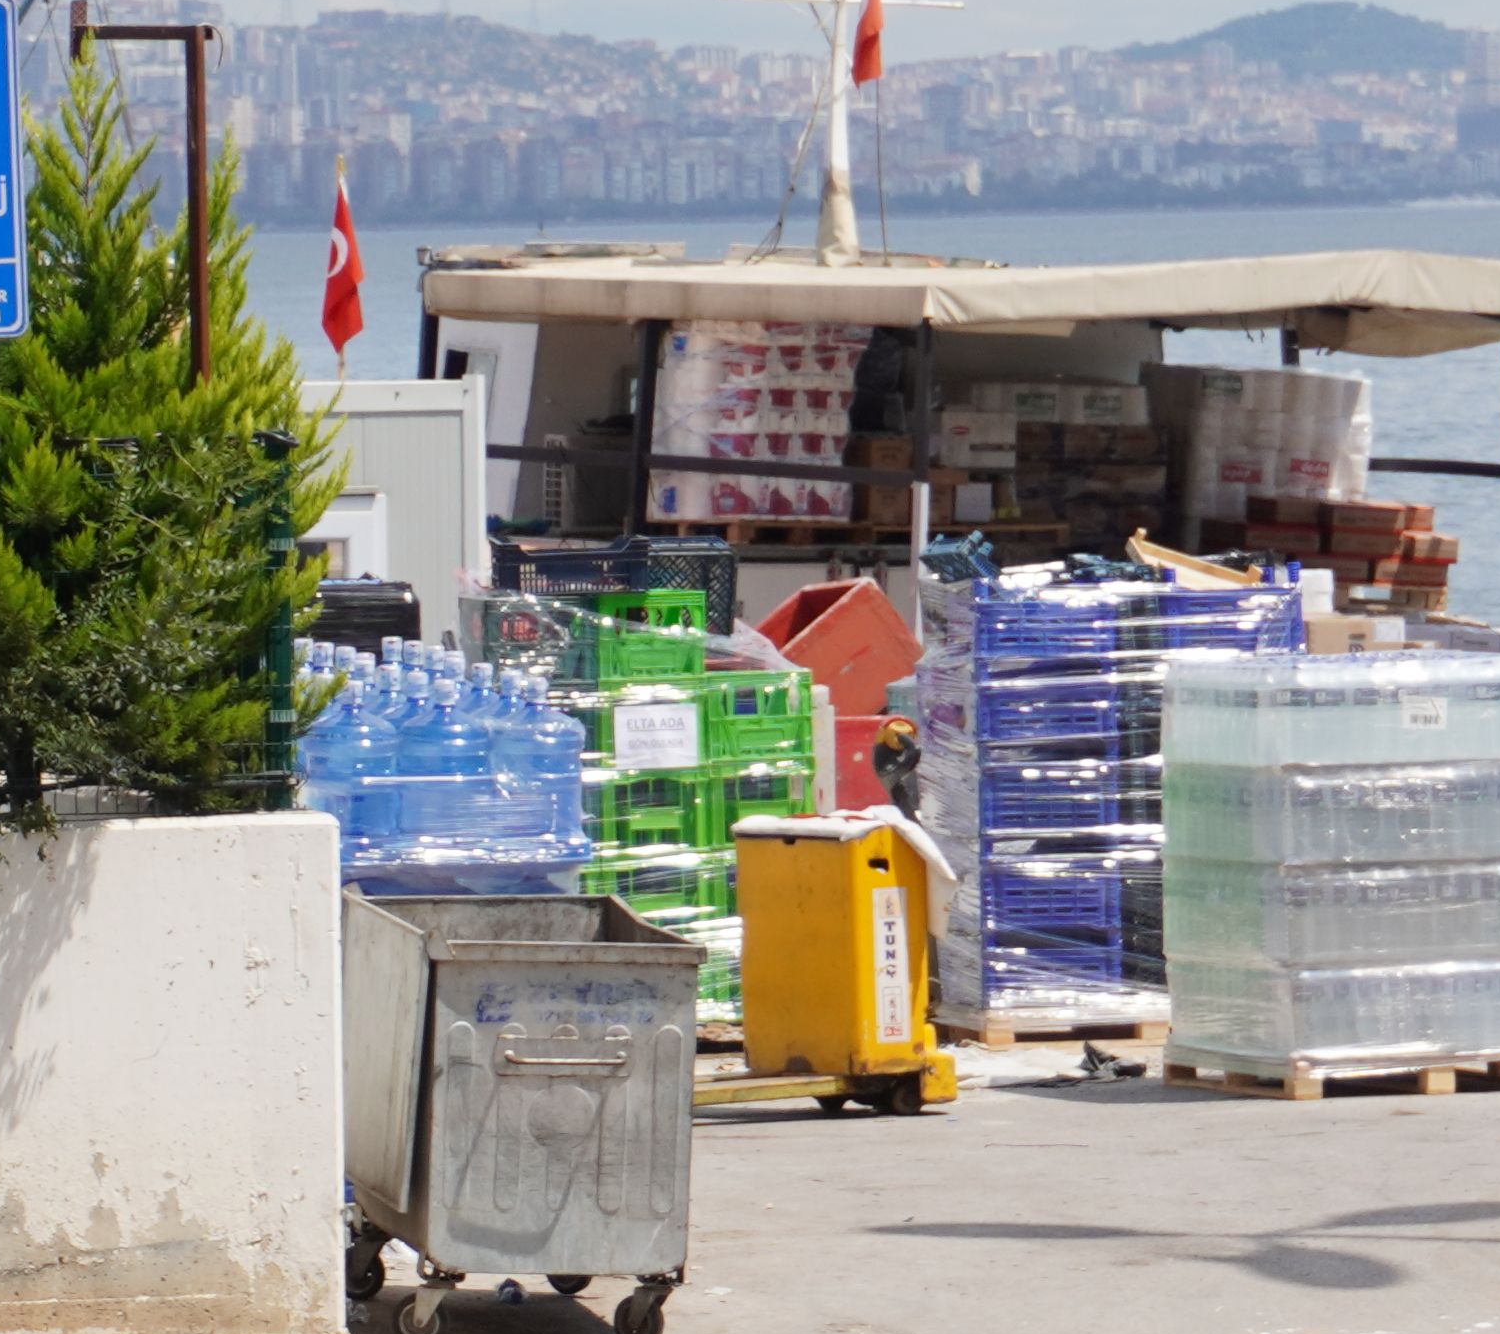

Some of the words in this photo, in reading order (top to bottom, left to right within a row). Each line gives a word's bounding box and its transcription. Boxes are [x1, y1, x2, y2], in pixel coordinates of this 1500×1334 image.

[626, 718, 655, 729] ELTA
[660, 716, 685, 728] ADA
[884, 921, 897, 979] TUNÇ
